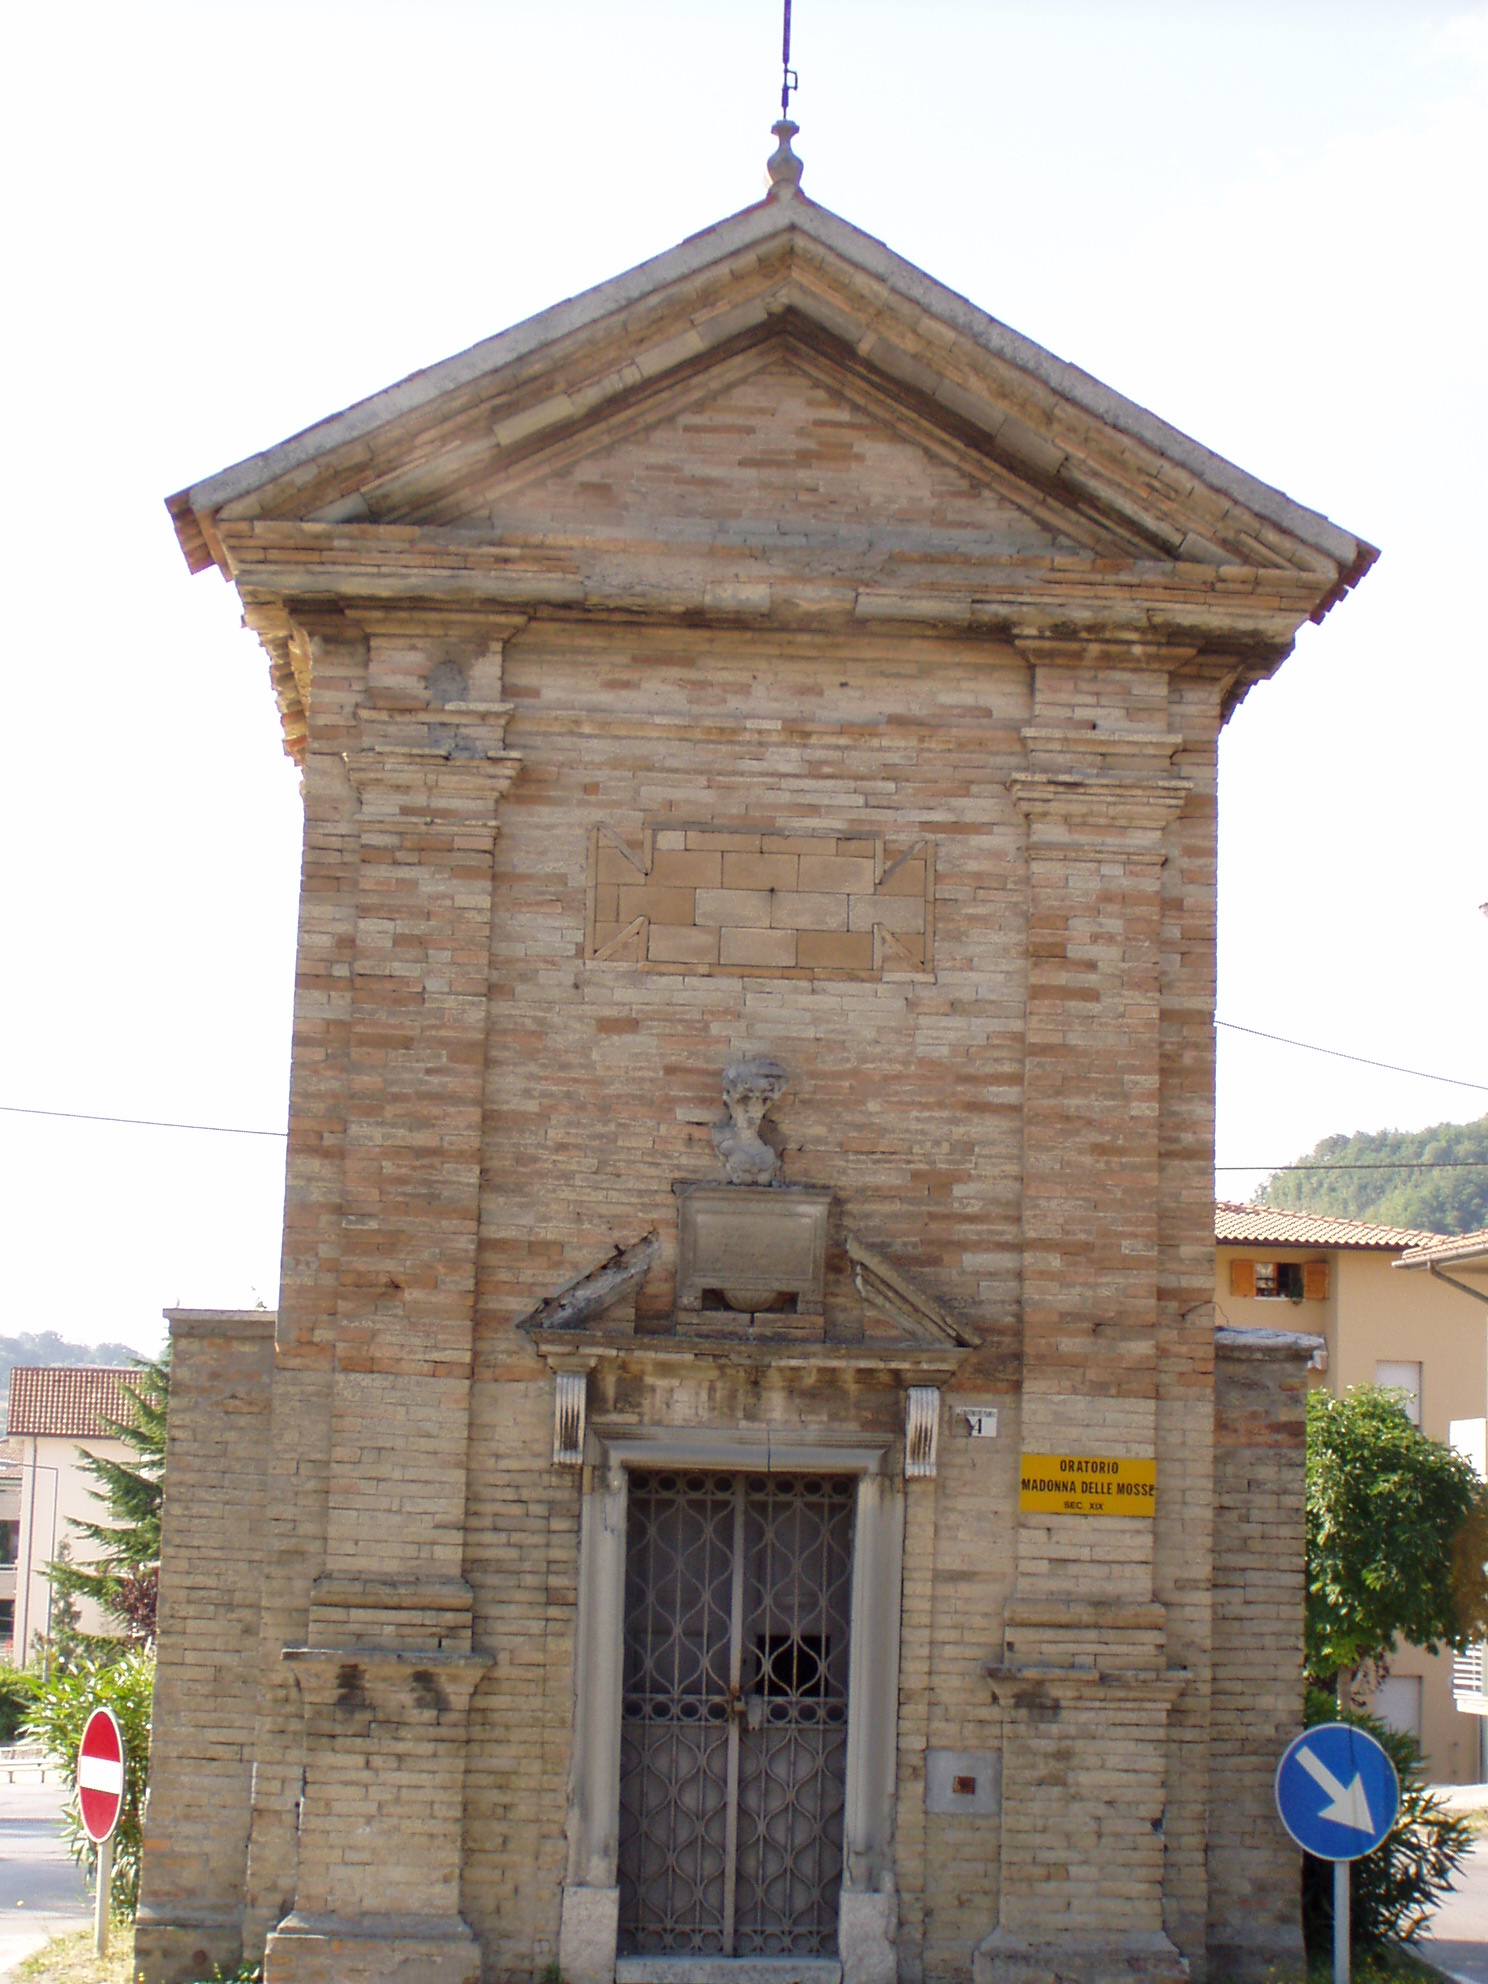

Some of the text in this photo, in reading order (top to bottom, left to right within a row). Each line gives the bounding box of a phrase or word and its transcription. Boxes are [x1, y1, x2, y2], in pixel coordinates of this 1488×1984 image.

[1060, 1459, 1119, 1474] ORATORIO
[1021, 1478, 1155, 1496] MADONNA DELLE MOSSE
[1089, 1502, 1104, 1511] XIX
